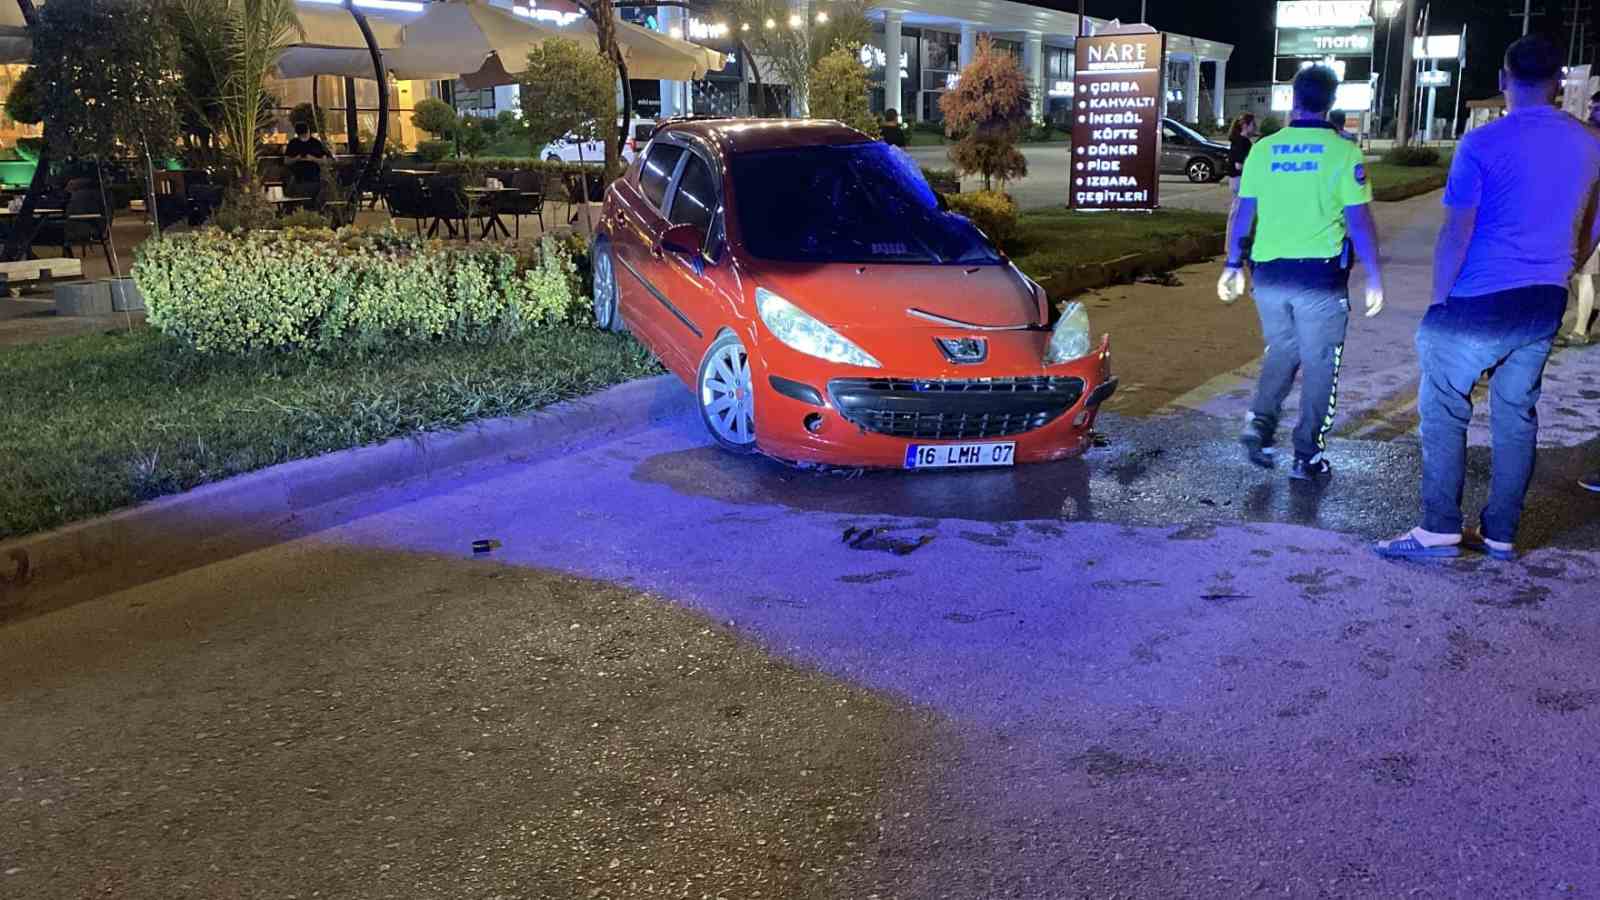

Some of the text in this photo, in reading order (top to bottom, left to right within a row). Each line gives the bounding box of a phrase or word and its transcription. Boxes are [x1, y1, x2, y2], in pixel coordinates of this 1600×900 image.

[1090, 81, 1140, 96] ÇORBA
[1089, 97, 1155, 108] KAHVALTI
[1093, 127, 1138, 140] KÖFTE
[1088, 143, 1138, 155] DÖNER
[1087, 158, 1120, 171] PİDE
[1087, 176, 1137, 186] IZGARA
[1076, 189, 1148, 204] ÇEŞİTLERİ
[918, 445, 1013, 464] 16 LMH 07
